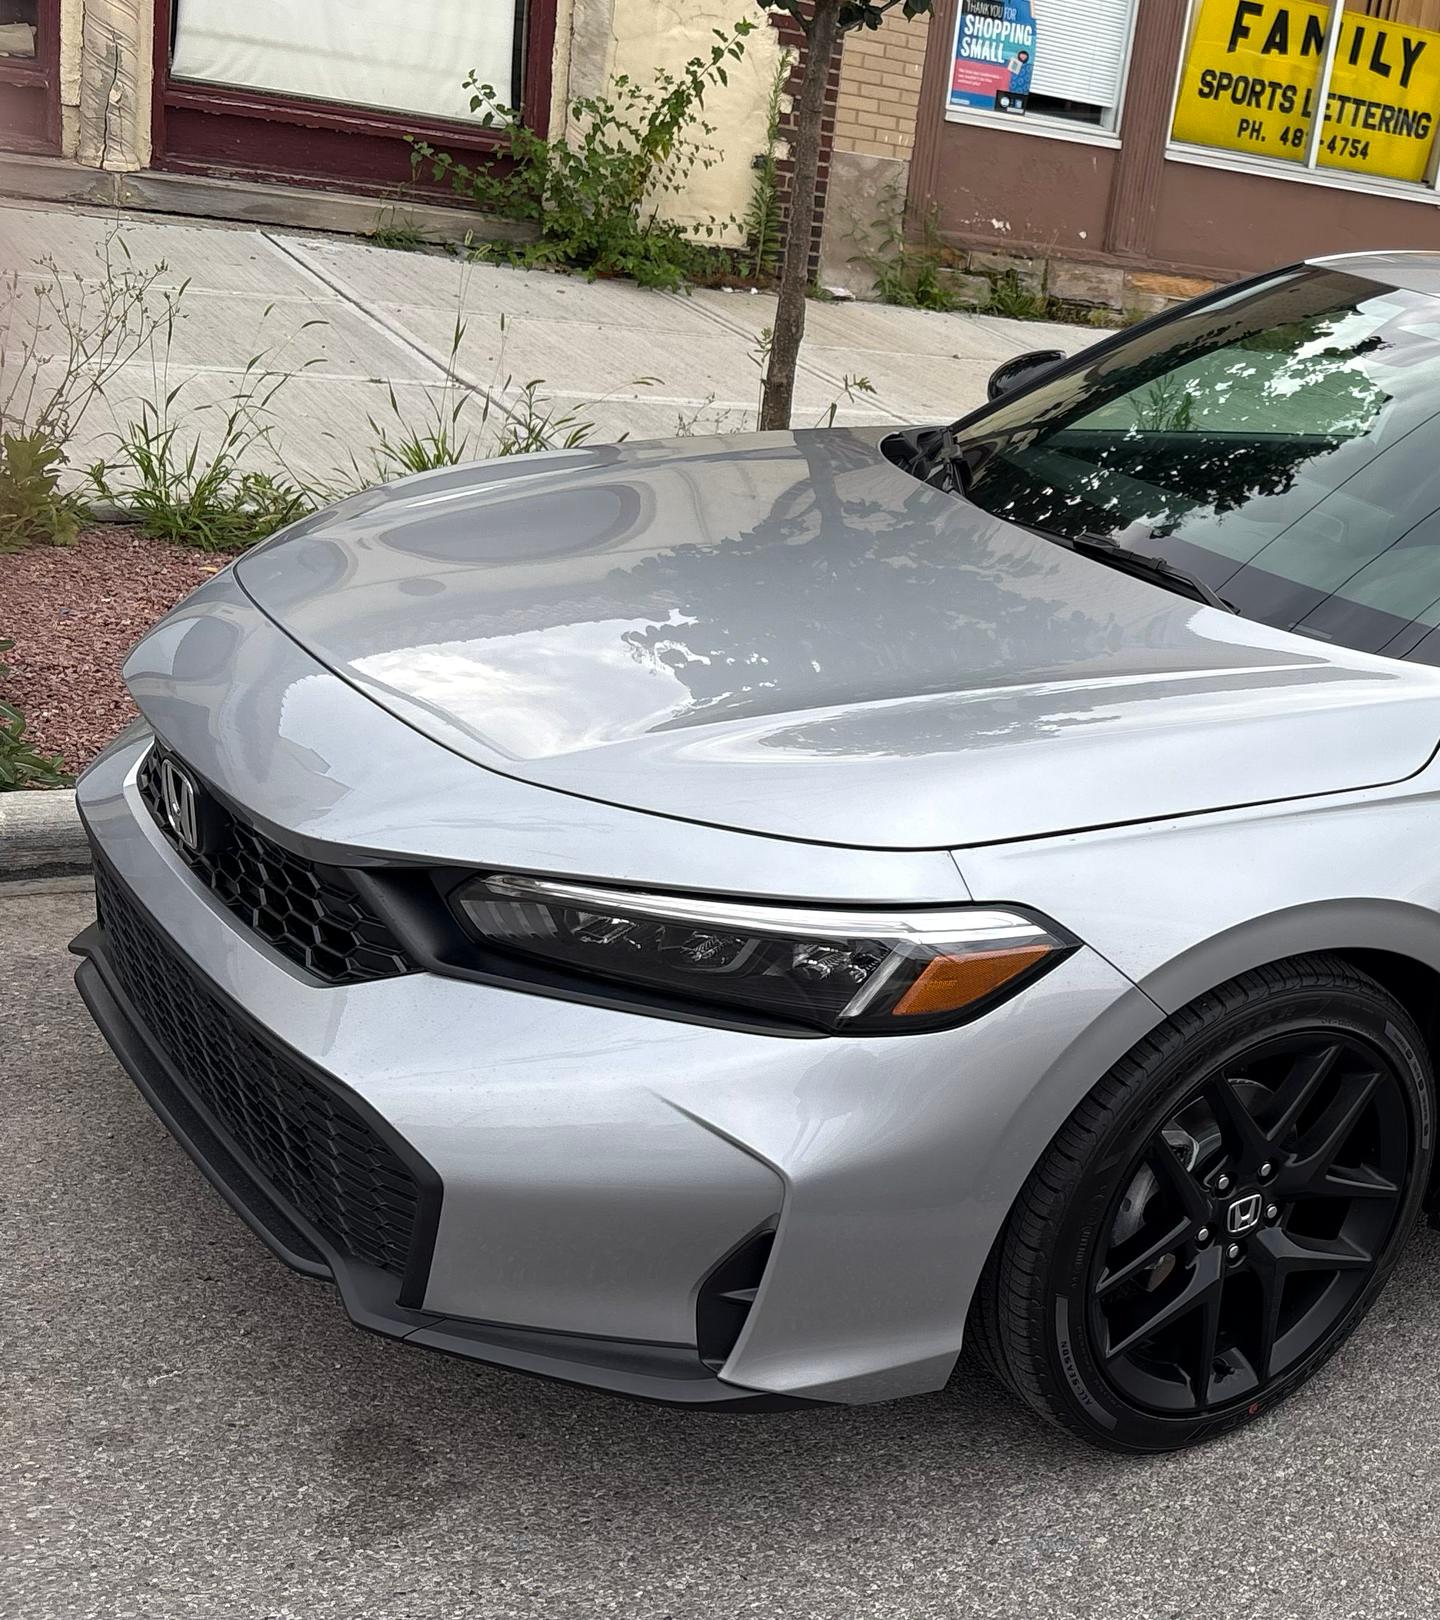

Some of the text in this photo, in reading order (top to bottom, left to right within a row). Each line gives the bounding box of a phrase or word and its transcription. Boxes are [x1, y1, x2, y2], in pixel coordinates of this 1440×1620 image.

[964, 14, 1032, 46] SHOPPING
[966, 0, 1017, 20] THANK YOU FOR
[960, 36, 1004, 63] SMALL
[1227, 0, 1427, 88] FAMILY
[1198, 69, 1297, 114] SPORTS
[1301, 88, 1432, 140] LETTERING
[1237, 118, 1370, 160] PH. 48-4754
[1060, 1339, 1094, 1406] ALL-SEASON
